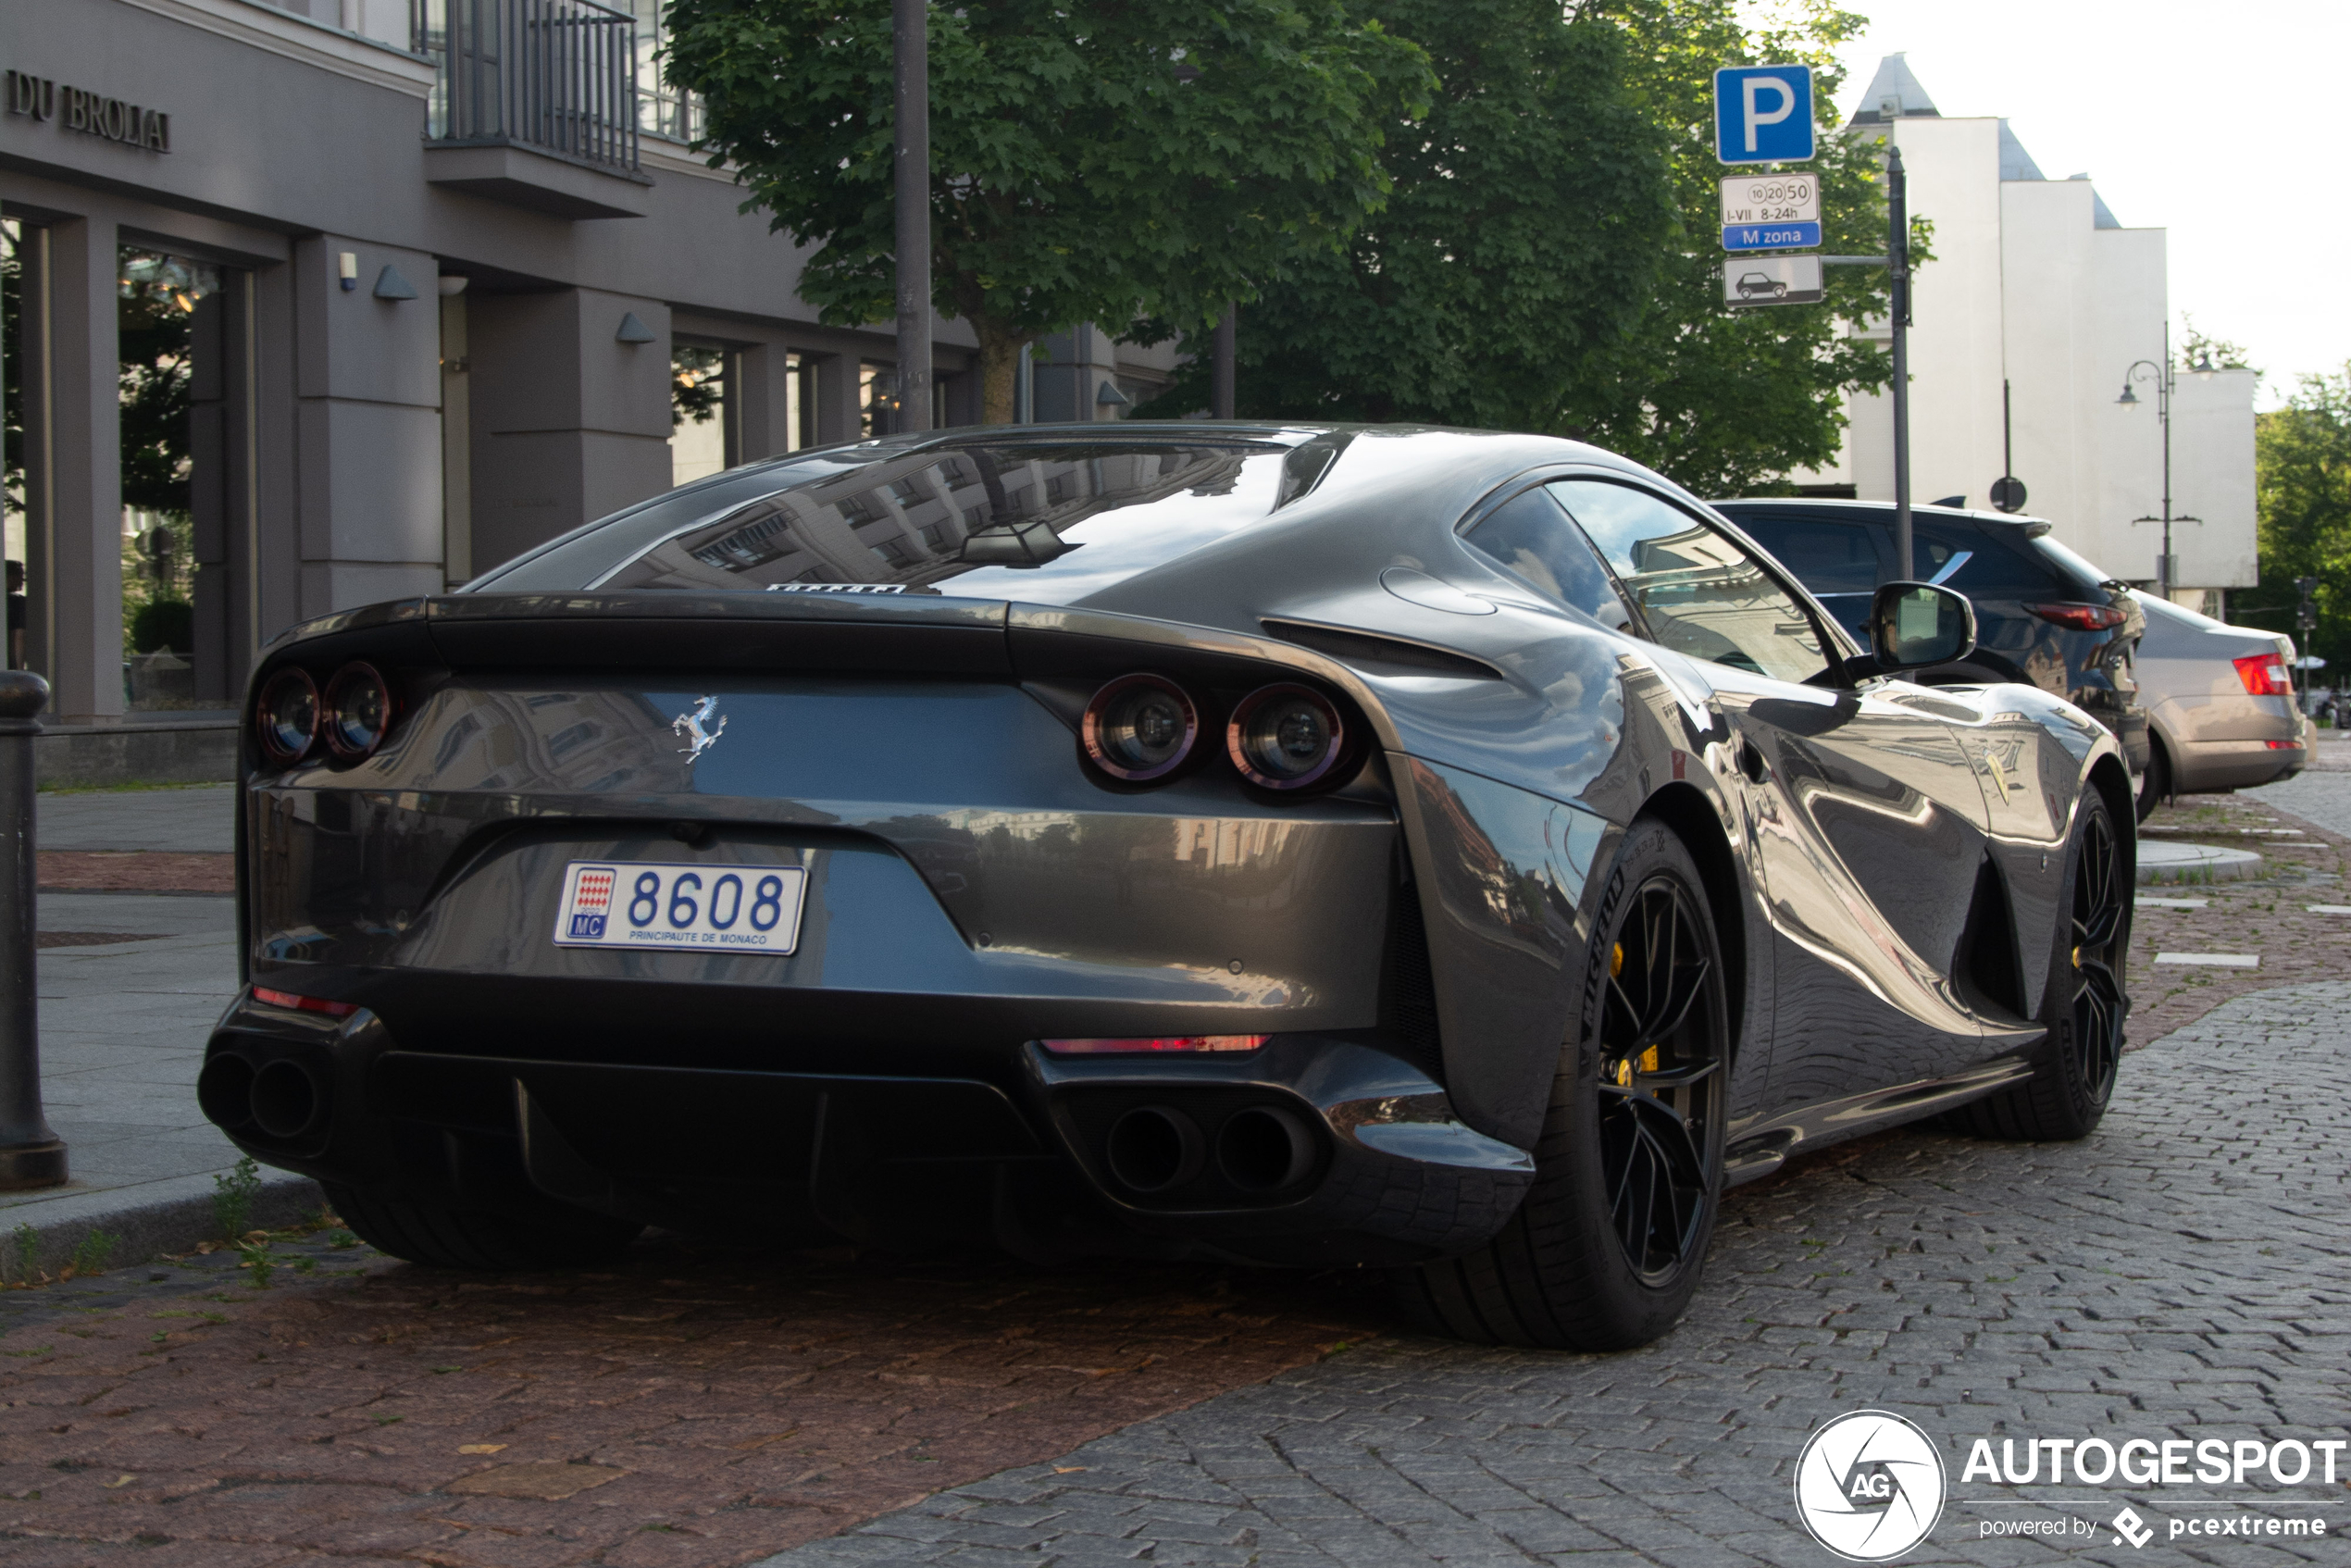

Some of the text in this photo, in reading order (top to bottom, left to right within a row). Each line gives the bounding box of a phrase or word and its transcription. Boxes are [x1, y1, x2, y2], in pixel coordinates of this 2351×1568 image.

[6, 69, 55, 122] DU
[1742, 77, 1795, 152] P
[1752, 185, 1808, 199] 10 20 50
[1727, 207, 1797, 221] I-VII 8-24h
[1743, 230, 1801, 244] M zona
[628, 871, 783, 931] 8608
[575, 916, 600, 936] MC
[629, 930, 767, 945] PRINCIPAUTE DE MONACO
[1582, 872, 1623, 1028] MICHELIN
